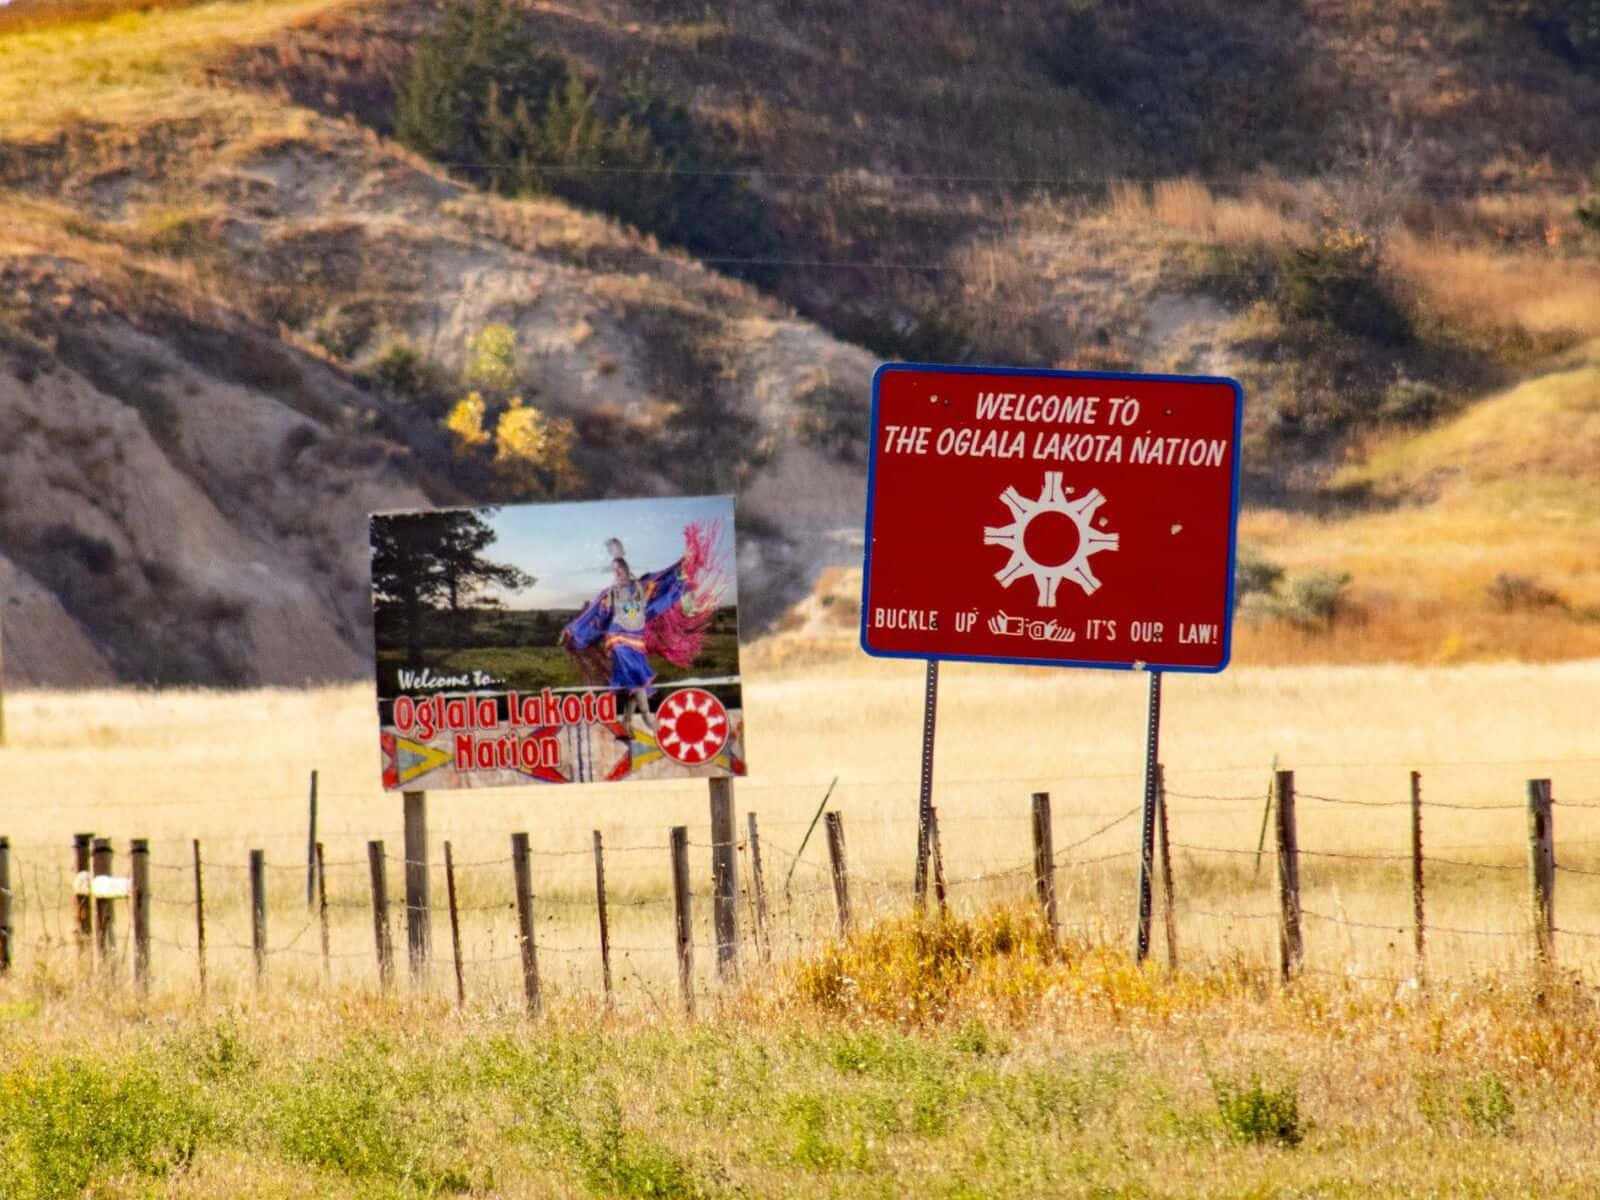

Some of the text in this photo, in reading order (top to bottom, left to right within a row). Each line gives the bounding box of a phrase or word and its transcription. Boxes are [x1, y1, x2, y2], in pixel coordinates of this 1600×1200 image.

[975, 392, 1140, 426] WELCOME TO
[884, 426, 1226, 467] THE OGLALA LAKOTA NATION
[875, 608, 1218, 644] BUCKLE UP IT'S OUR LAW!
[397, 669, 470, 690] Welcome
[394, 688, 617, 741] Oglala Lakota
[455, 732, 560, 770] Nation
